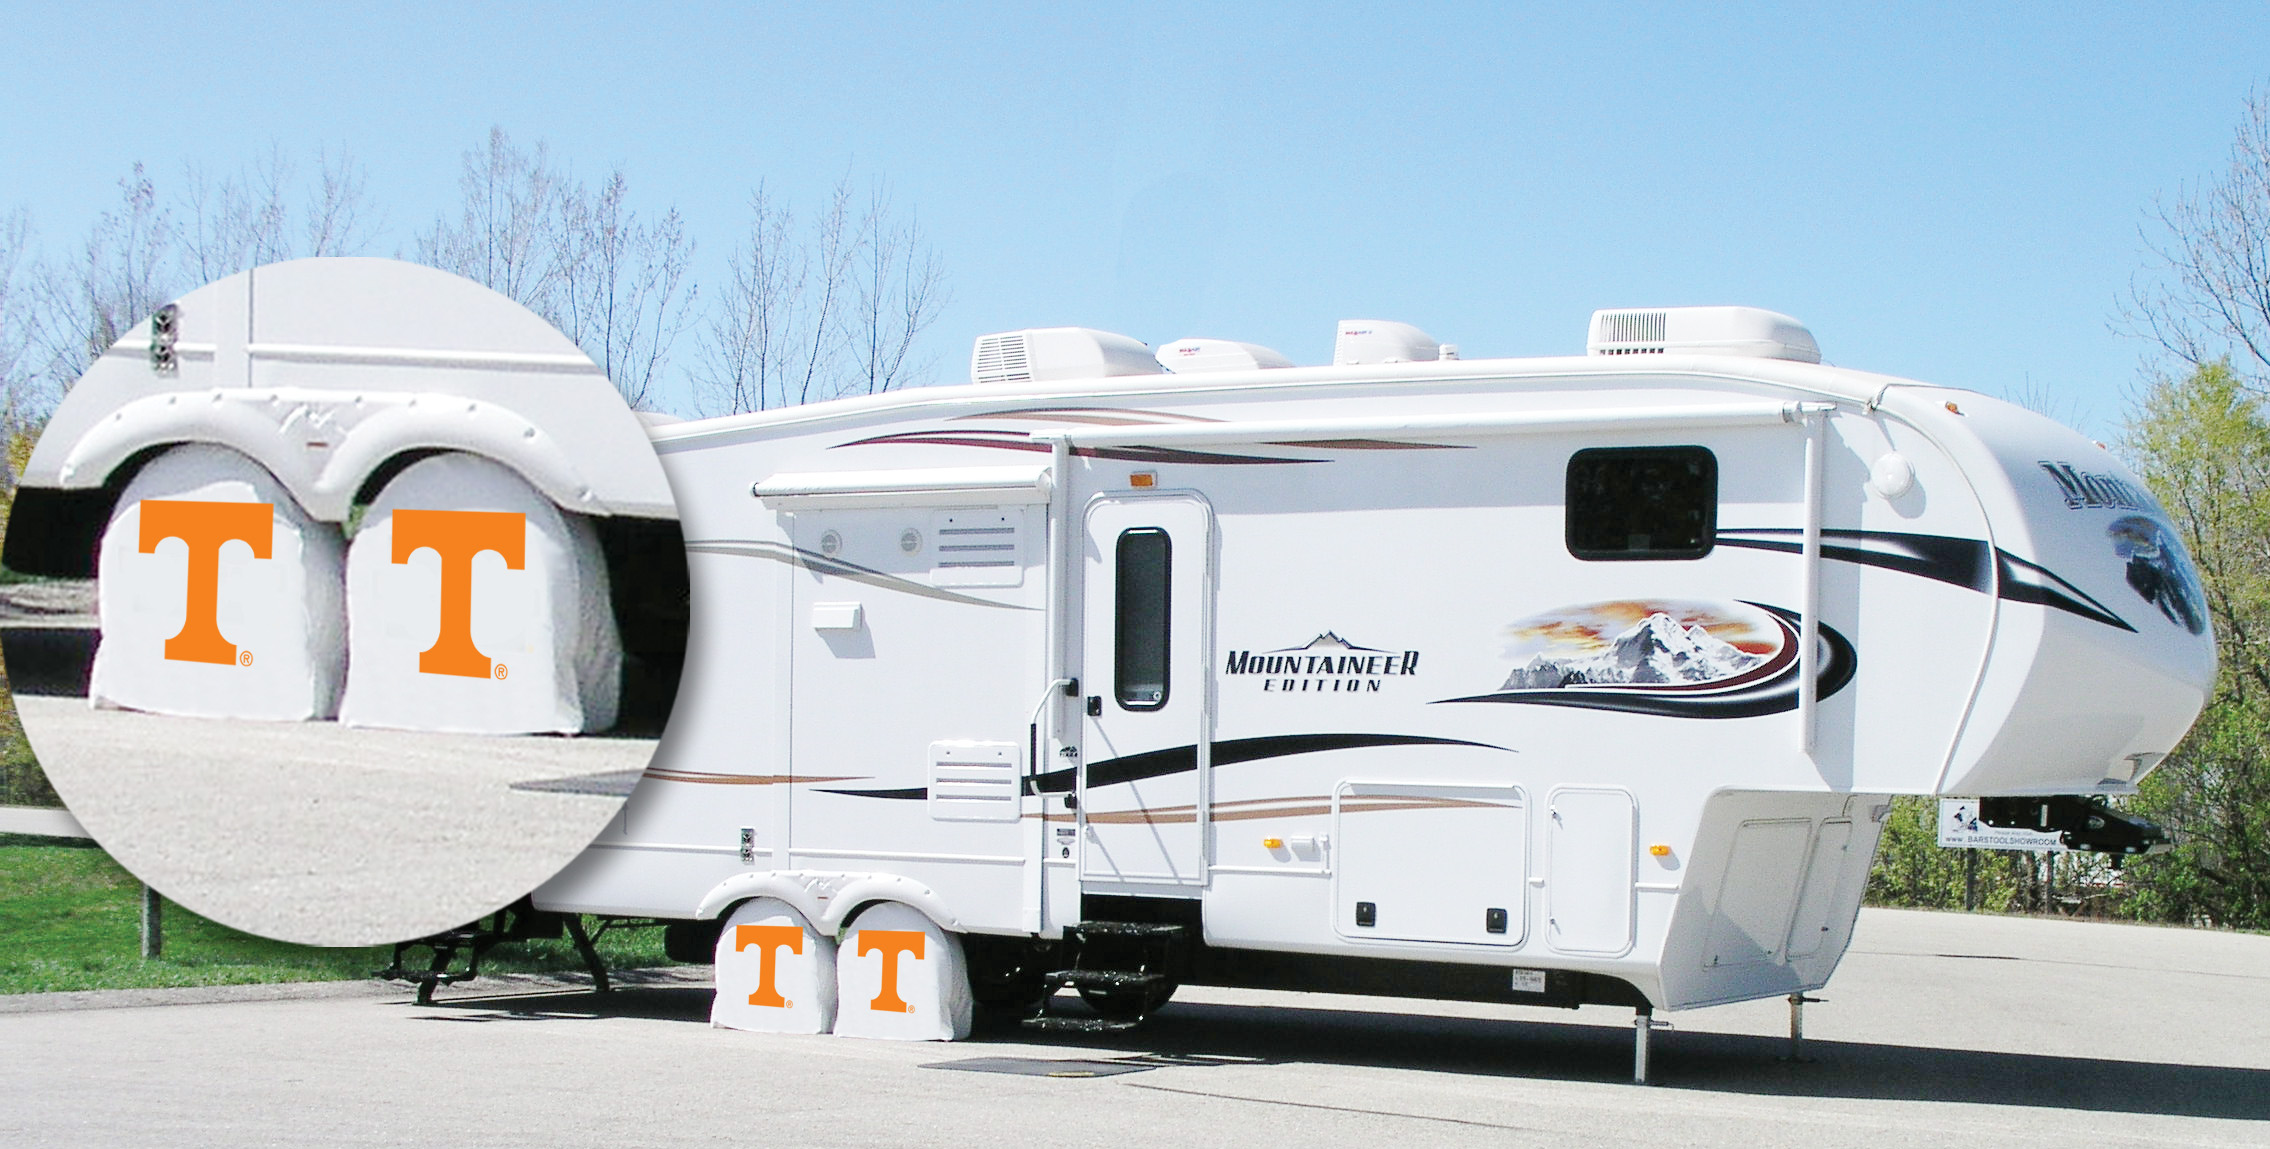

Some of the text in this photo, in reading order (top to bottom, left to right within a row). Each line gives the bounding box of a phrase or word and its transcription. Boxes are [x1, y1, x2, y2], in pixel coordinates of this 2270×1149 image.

[139, 500, 274, 666] T
[391, 509, 526, 679] T
[1225, 651, 1419, 675] MOUNTAINEER
[1263, 679, 1381, 692] EDITION
[735, 924, 804, 1008] T
[857, 929, 926, 1013] T
